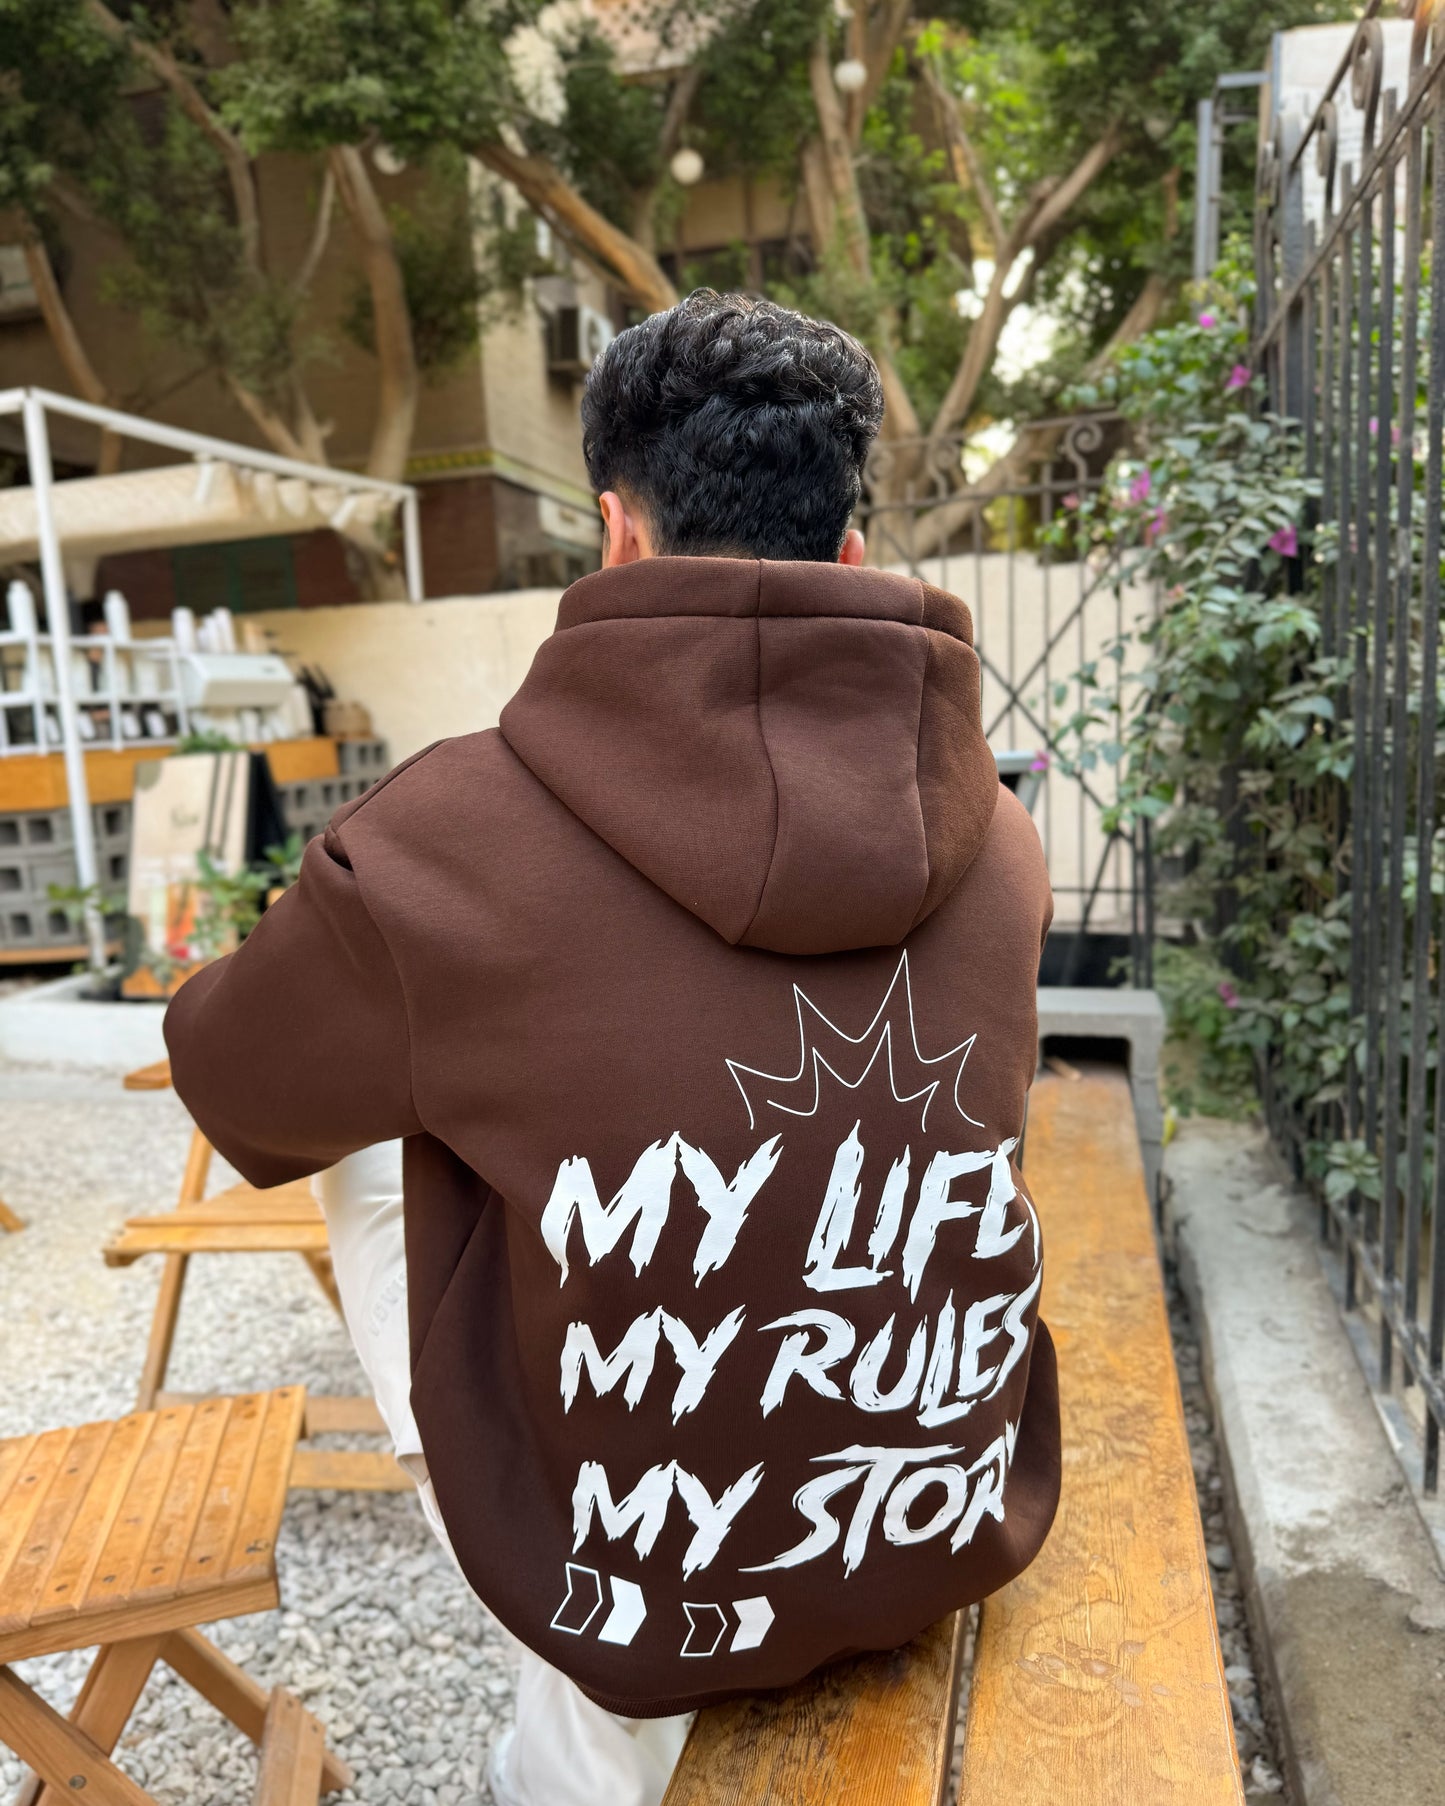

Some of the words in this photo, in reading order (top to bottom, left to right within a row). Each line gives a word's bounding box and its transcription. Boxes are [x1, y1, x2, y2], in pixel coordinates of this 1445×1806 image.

[540, 1130, 783, 1289] MY
[560, 1303, 747, 1426] MY
[757, 1262, 1043, 1429] RULES
[571, 1458, 765, 1582] MY
[738, 1418, 1021, 1580] STOR
